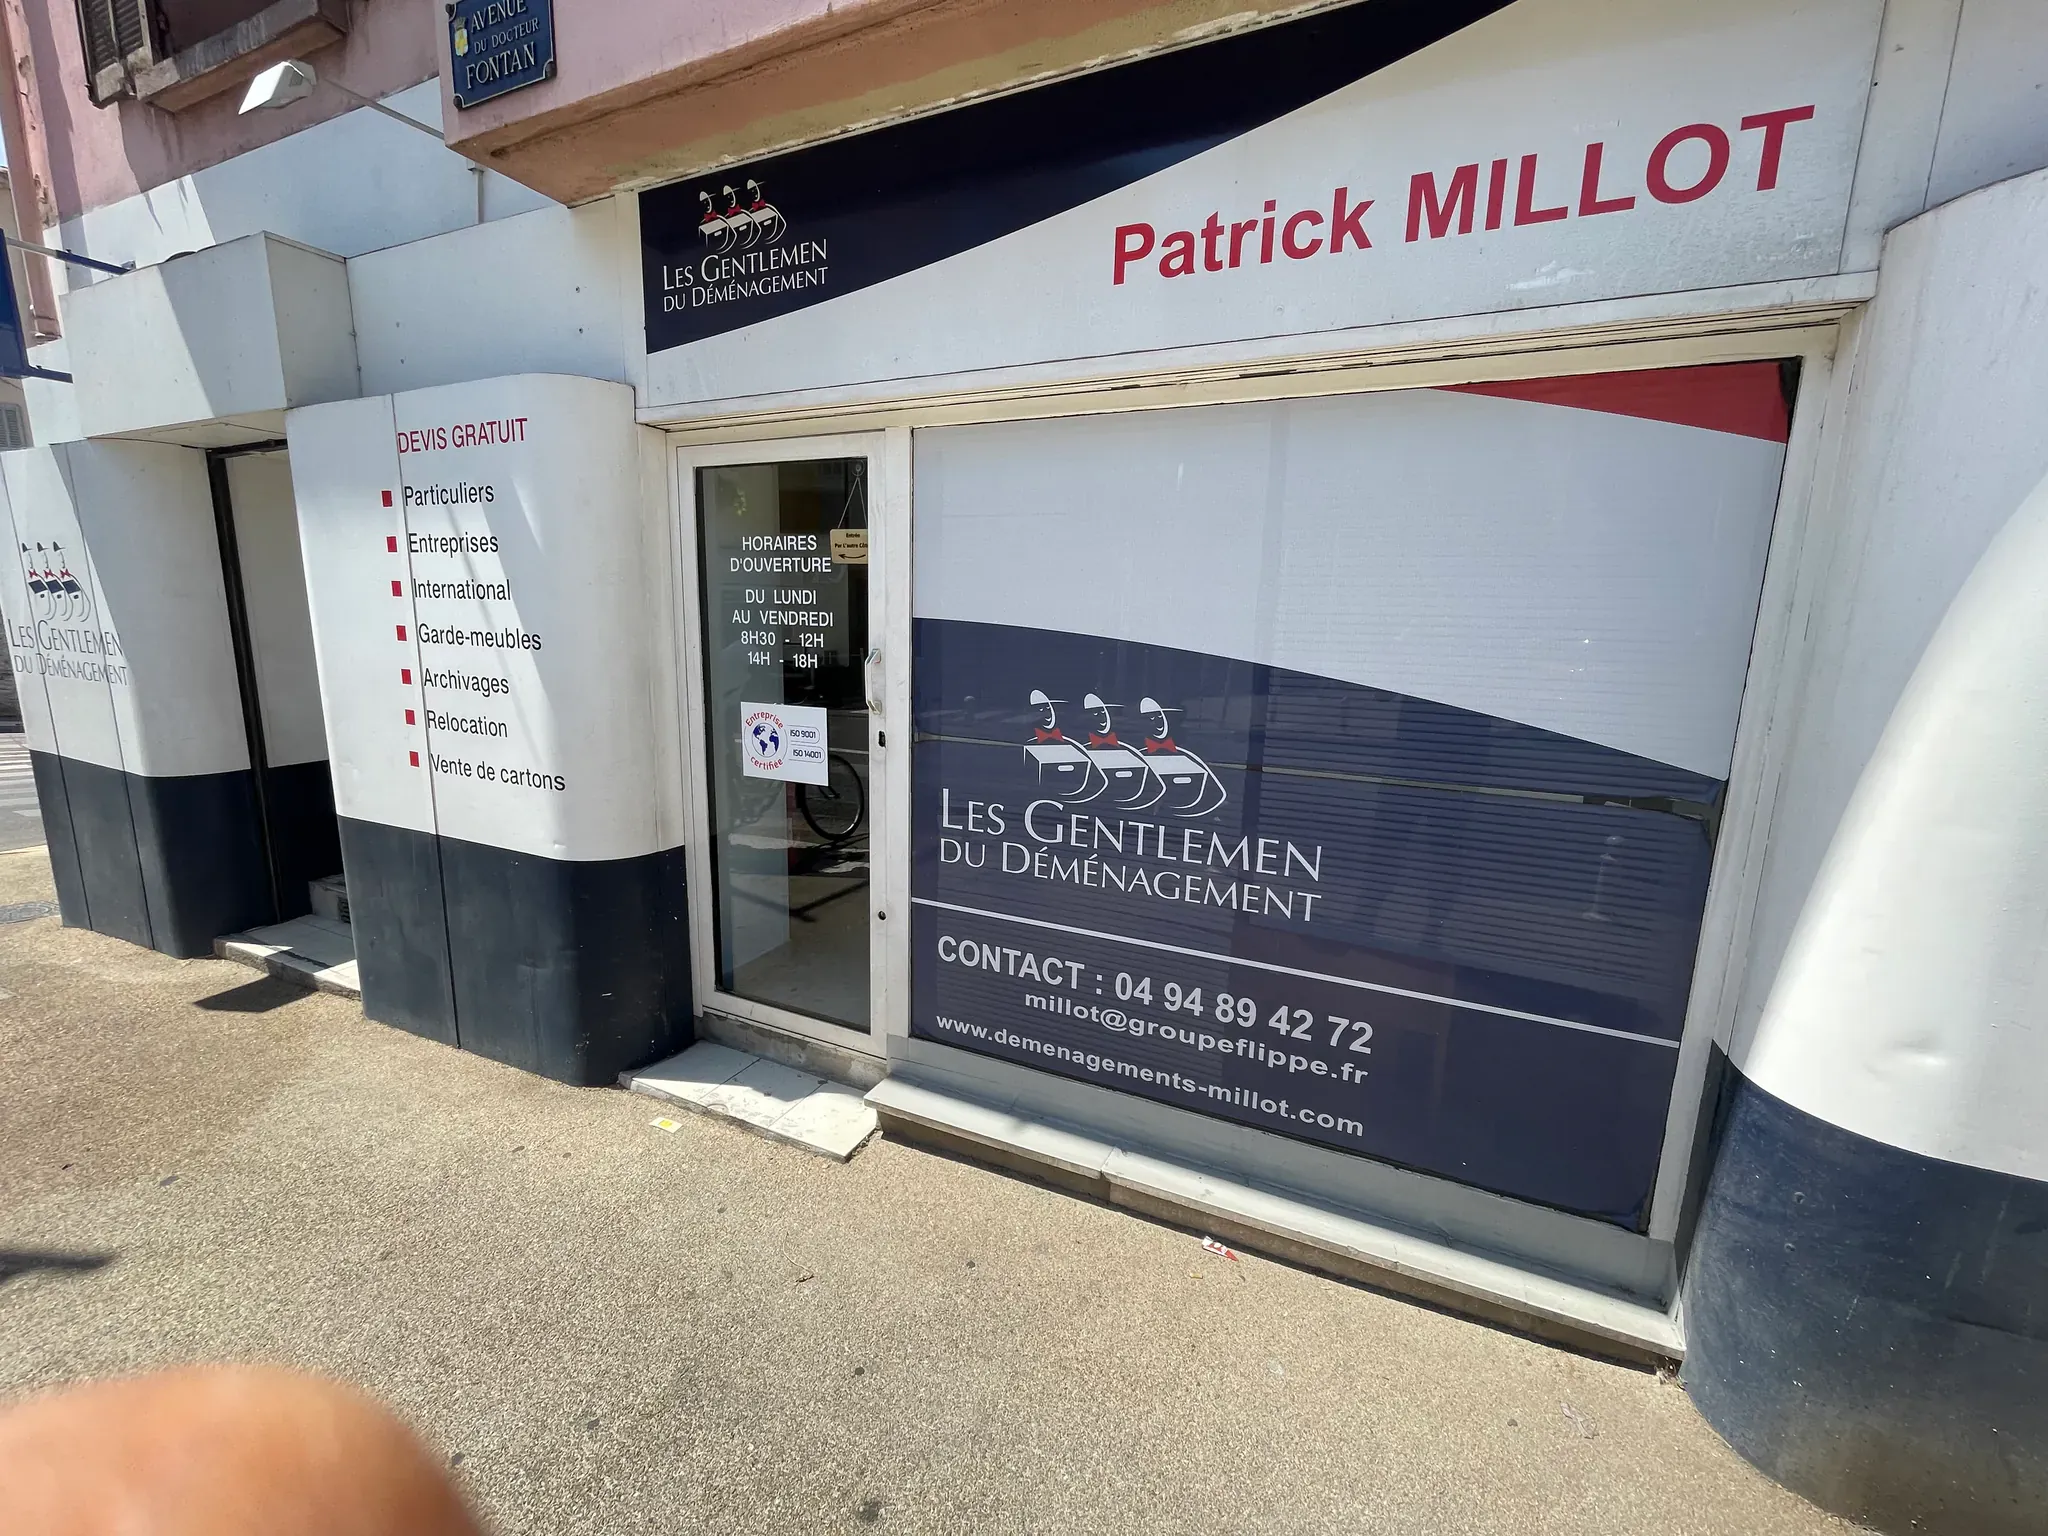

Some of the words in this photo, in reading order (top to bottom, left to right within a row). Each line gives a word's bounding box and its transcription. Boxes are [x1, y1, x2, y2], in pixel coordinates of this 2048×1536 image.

[470, 0, 527, 33] AVENUE
[474, 38, 487, 54] DU
[491, 17, 540, 48] DOCTEUR
[466, 41, 536, 89] FONTAN
[1112, 187, 1375, 285] Patrick
[1404, 104, 1816, 243] MILLOT
[663, 265, 694, 290] LES
[701, 238, 828, 282] GENTLEMEN
[692, 267, 829, 307] DÉMÉNAGEMENT
[397, 427, 448, 453] DEVIS
[452, 417, 528, 448] GRATUIT
[404, 482, 495, 506] Particuliers
[408, 532, 499, 558] Entreprises
[742, 535, 817, 551] HORAIRES
[730, 557, 832, 573] D'OUVERTURE
[413, 578, 512, 601] International
[745, 589, 765, 604] DU
[773, 589, 817, 605] LUNDI
[8, 618, 35, 649] LES
[732, 610, 751, 624] AU
[759, 610, 834, 627] VENDREDI
[418, 623, 542, 650] Garde-meubles
[741, 631, 776, 646] 8H30
[799, 633, 824, 648] 12H
[748, 651, 771, 666] 14H
[793, 653, 818, 669] 18H
[424, 667, 510, 698] Archivages
[426, 709, 508, 738] Relocation
[745, 712, 784, 729] Entreprise
[790, 730, 801, 738] ISO
[801, 730, 816, 738] 9001
[793, 750, 804, 758] ISO
[804, 750, 822, 759] 14001
[430, 753, 473, 778] Vente
[476, 761, 496, 781] de
[500, 768, 566, 792] cartons
[941, 788, 1006, 836] LES
[1023, 799, 1323, 882] GENTLEMEN
[1001, 842, 1323, 922] DÉMÉNAGEMENT
[938, 935, 1085, 990] CONTACT
[1114, 971, 1153, 1006] 04
[1163, 982, 1204, 1017] 94
[1214, 992, 1257, 1028] 89
[1268, 1005, 1313, 1041] 42
[1327, 1015, 1374, 1055] 72
[1024, 990, 1369, 1085] millot@groupeflippe.fr
[936, 1013, 1364, 1137] www.demenagements-millot.com
